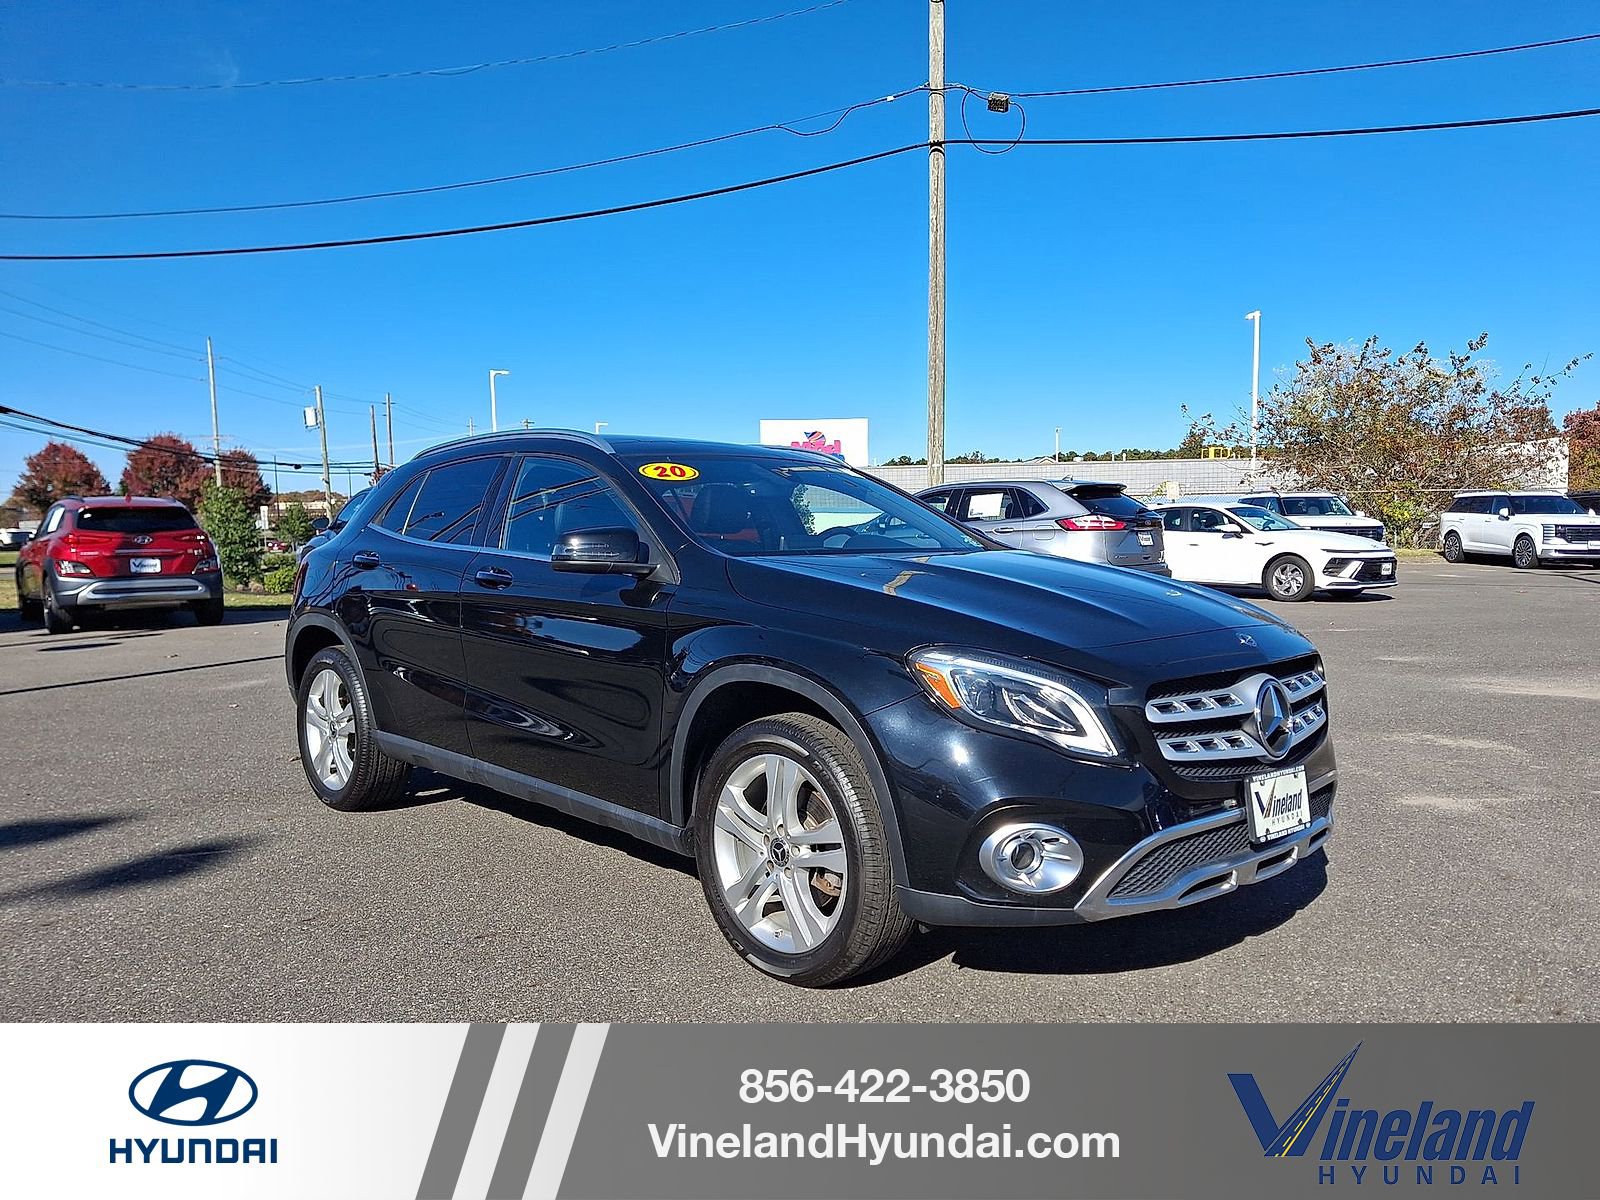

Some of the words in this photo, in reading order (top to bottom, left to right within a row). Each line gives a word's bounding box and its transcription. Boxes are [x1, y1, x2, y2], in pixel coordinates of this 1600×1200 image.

[653, 465, 687, 478] 20
[1254, 779, 1303, 819] Vineland
[1271, 811, 1303, 826] HYUNDAI
